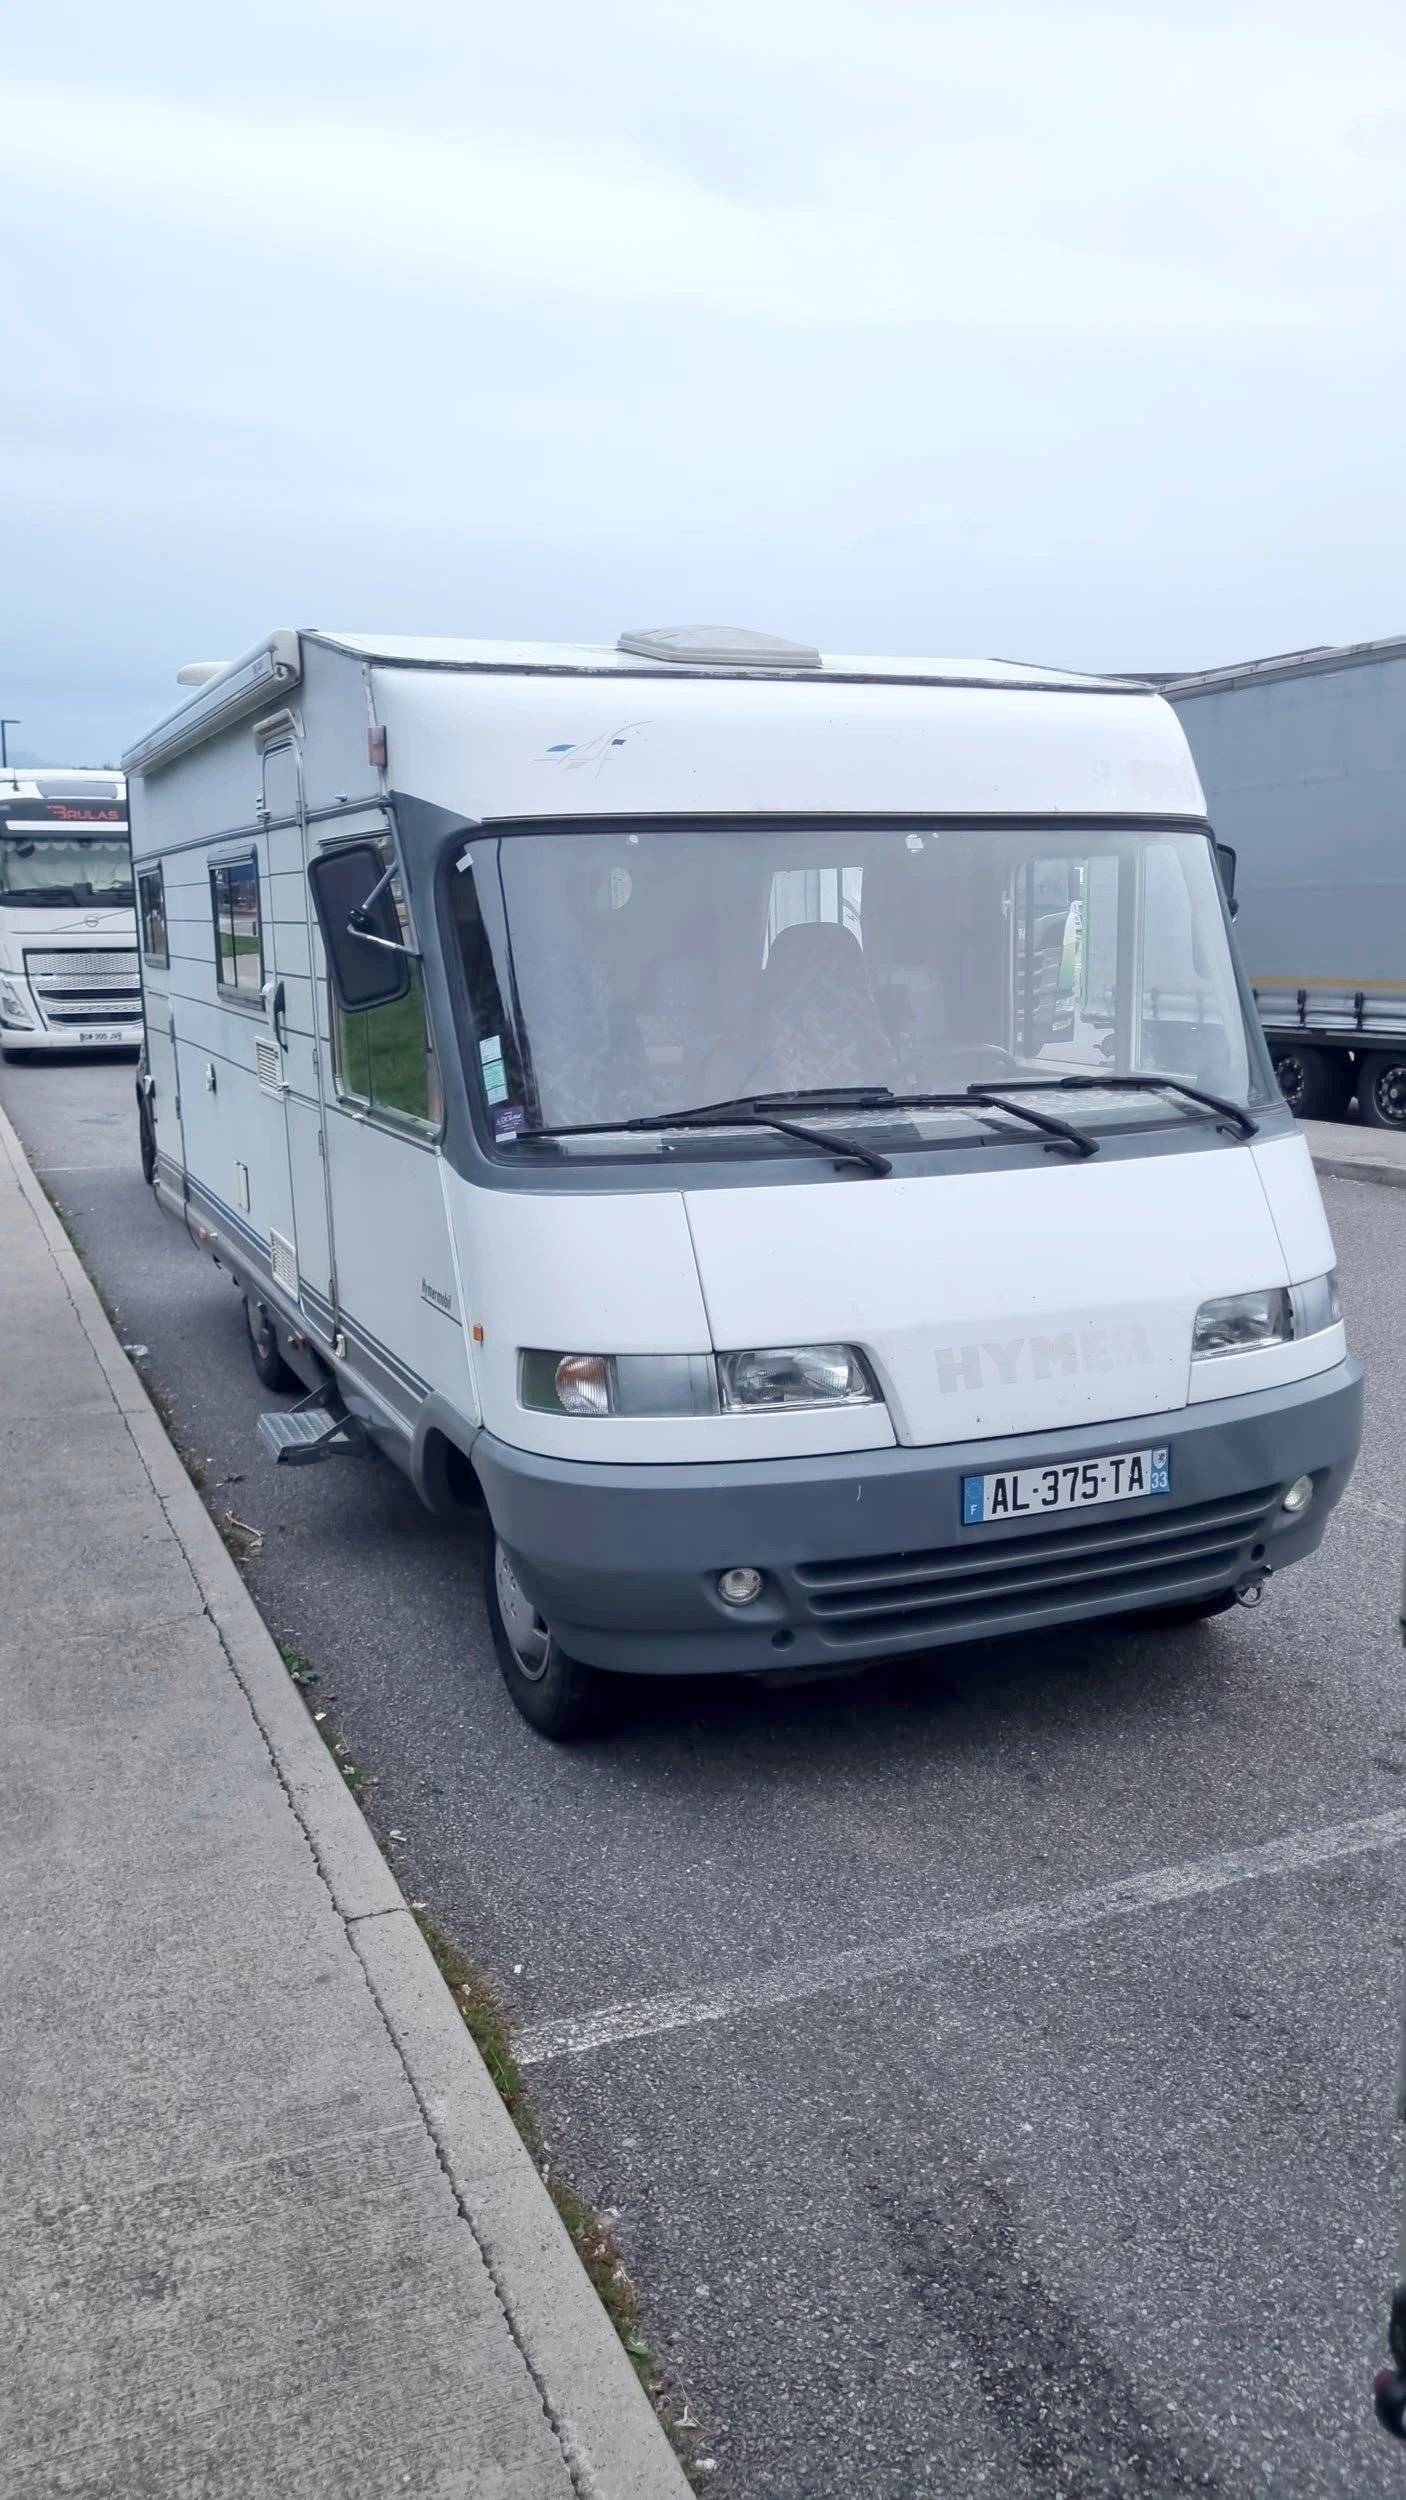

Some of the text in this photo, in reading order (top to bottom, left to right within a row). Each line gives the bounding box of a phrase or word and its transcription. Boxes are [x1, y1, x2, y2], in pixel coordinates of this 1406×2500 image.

[934, 1325, 1155, 1394] HYMER
[969, 1504, 978, 1516] F
[1151, 1471, 1168, 1489] 33
